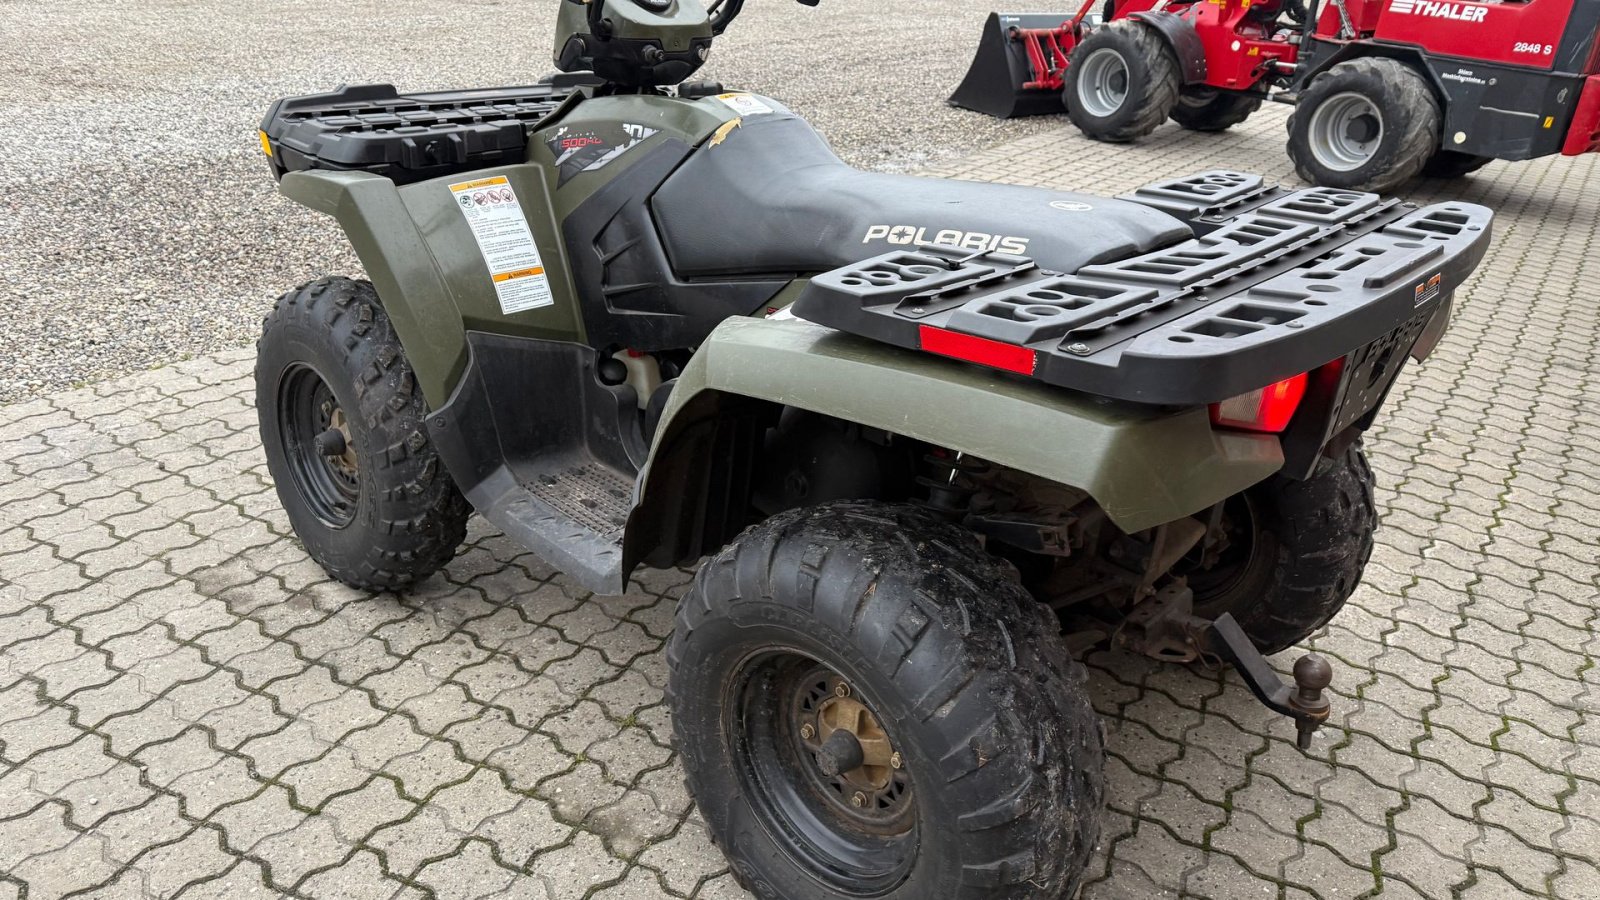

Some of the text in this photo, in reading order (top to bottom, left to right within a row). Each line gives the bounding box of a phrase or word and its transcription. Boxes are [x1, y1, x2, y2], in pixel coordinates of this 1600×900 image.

[1413, 0, 1488, 22] THALER
[1513, 41, 1553, 55] 2848 S
[862, 225, 1030, 255] POLARIS
